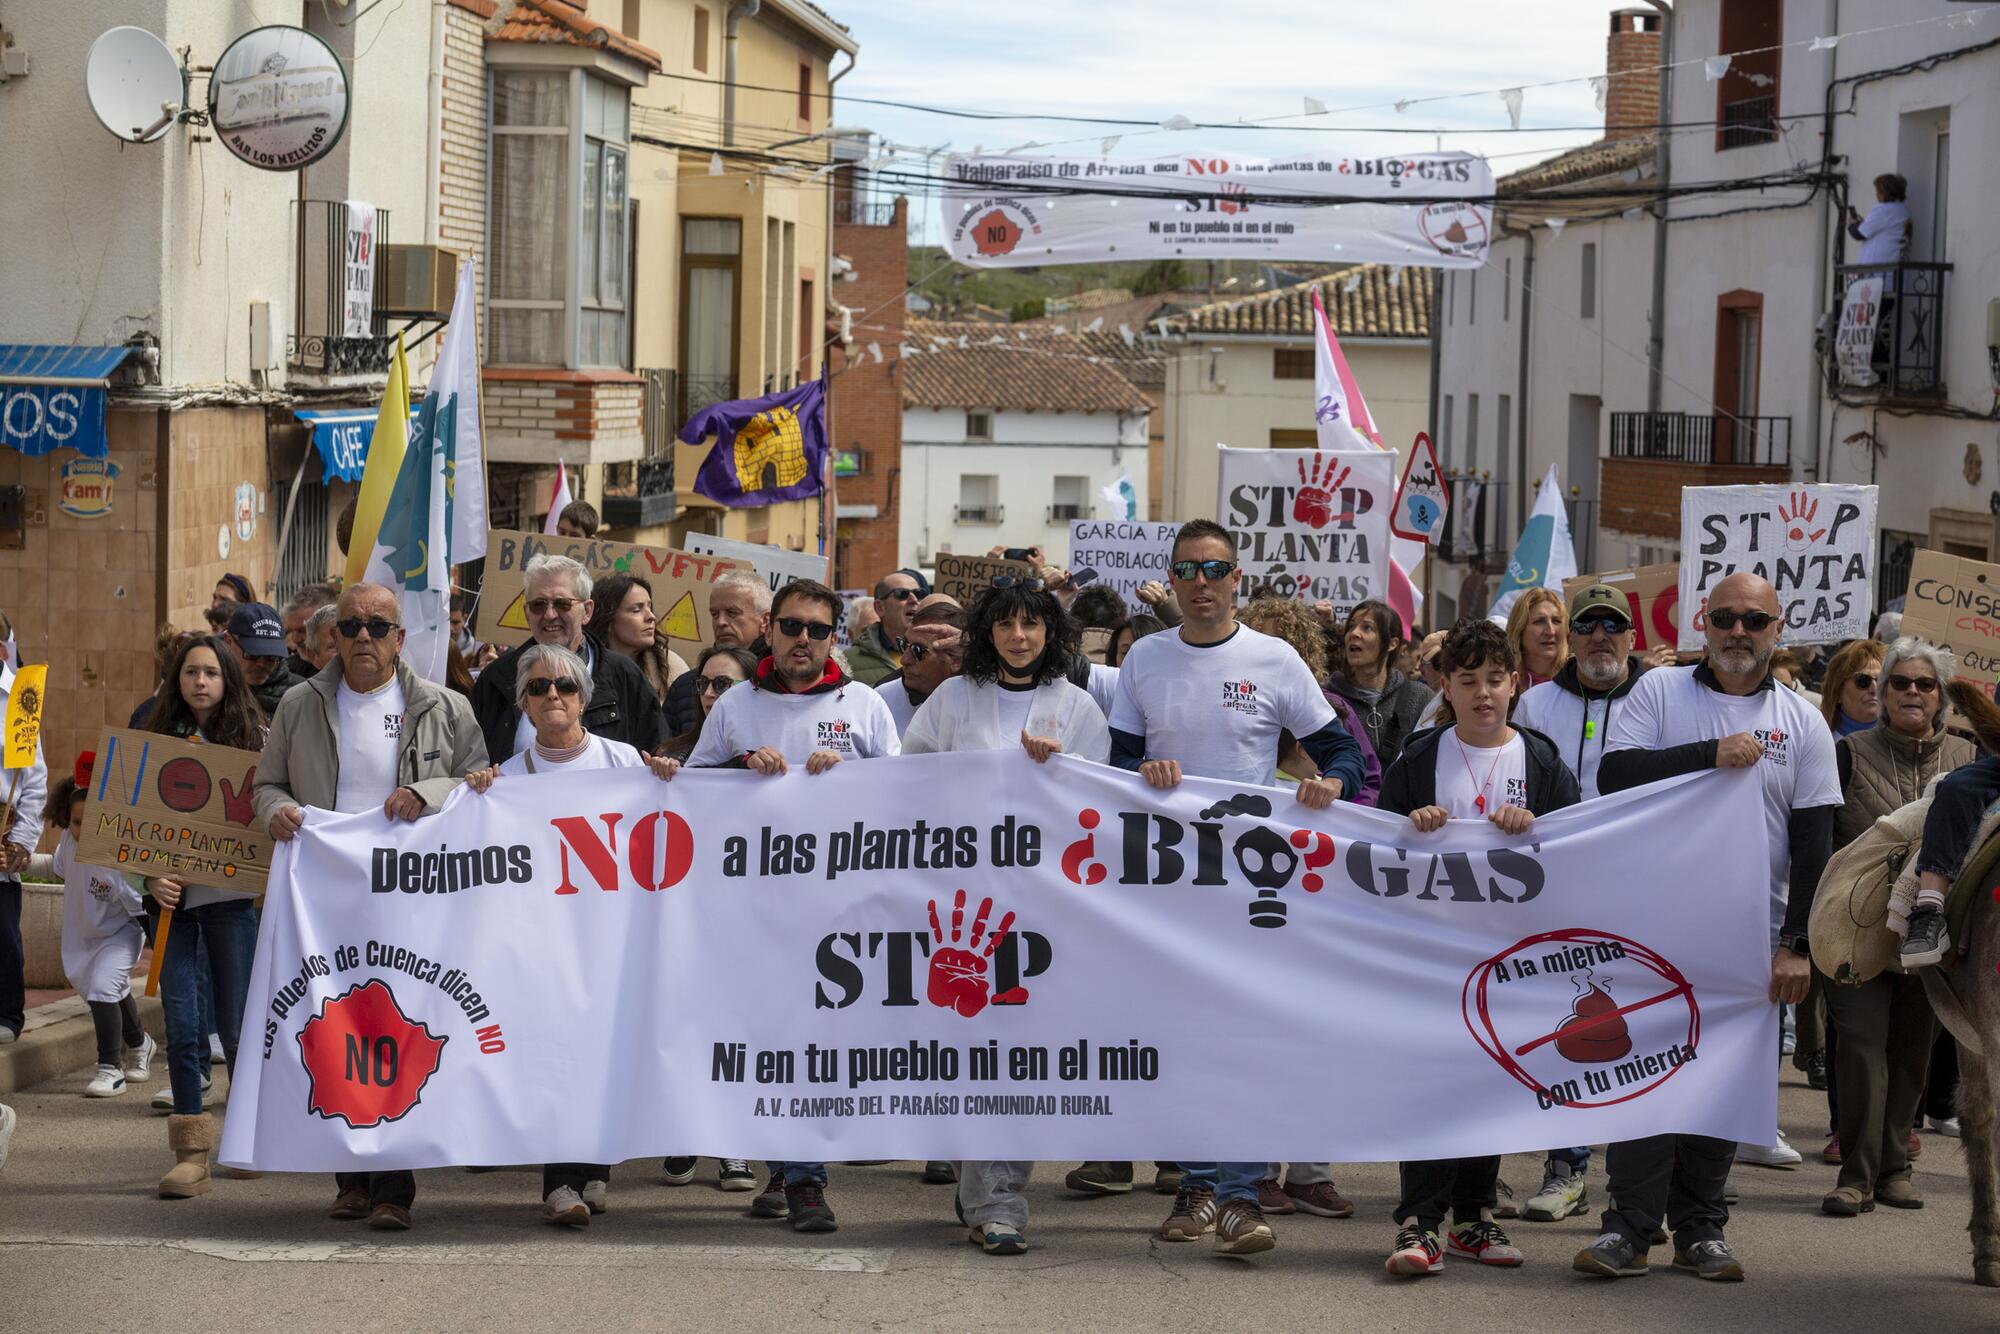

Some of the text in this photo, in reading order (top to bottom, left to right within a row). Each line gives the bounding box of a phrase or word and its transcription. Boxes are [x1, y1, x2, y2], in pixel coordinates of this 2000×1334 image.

[231, 126, 327, 165] BAR LOS MELLIZOS
[1059, 161, 1079, 176] de
[1153, 163, 1178, 173] dice
[1186, 158, 1229, 176] NO
[1317, 160, 1332, 172] de
[987, 225, 1006, 244] NO
[1149, 221, 1160, 234] Ni
[1163, 222, 1176, 233] en
[1180, 221, 1192, 233] tu
[1194, 220, 1230, 235] pueblo
[1233, 221, 1243, 233] ni
[1246, 222, 1259, 233] en
[1262, 221, 1272, 233] el
[0, 391, 79, 440] OS
[1229, 452, 1374, 530] STOP
[1076, 523, 1147, 541] GARCIA
[1699, 491, 1860, 555] STOP
[1231, 531, 1370, 564] PLANTA
[1223, 679, 1257, 694] STOP
[1223, 692, 1257, 702] PLANTA
[817, 718, 851, 733] STOP
[817, 731, 851, 739] PLANTA
[1753, 727, 1789, 743] STOP
[97, 813, 257, 860] MACROPLANTAS
[371, 843, 533, 895] Decimos
[550, 809, 695, 896] NO
[722, 835, 748, 878] a
[759, 825, 817, 877] las
[826, 819, 978, 881] plantas
[990, 815, 1042, 868] de
[116, 844, 238, 878] BIOMETANO
[815, 889, 1053, 1019] STOP
[1493, 940, 1627, 984] A la mierda
[263, 1018, 279, 1060] Los
[334, 944, 360, 973] de
[365, 940, 442, 984] Cuenca
[438, 968, 491, 1025] dicen
[475, 1023, 506, 1055] NO
[345, 1032, 399, 1088] NO
[711, 1038, 1160, 1089] Ni en tu pueblo ni en el mio
[1536, 1043, 1699, 1111] con tu mierda
[754, 1092, 1114, 1118] A.V. CAMPOS DEL PARAÍSO COMUNIDAD RURAL
